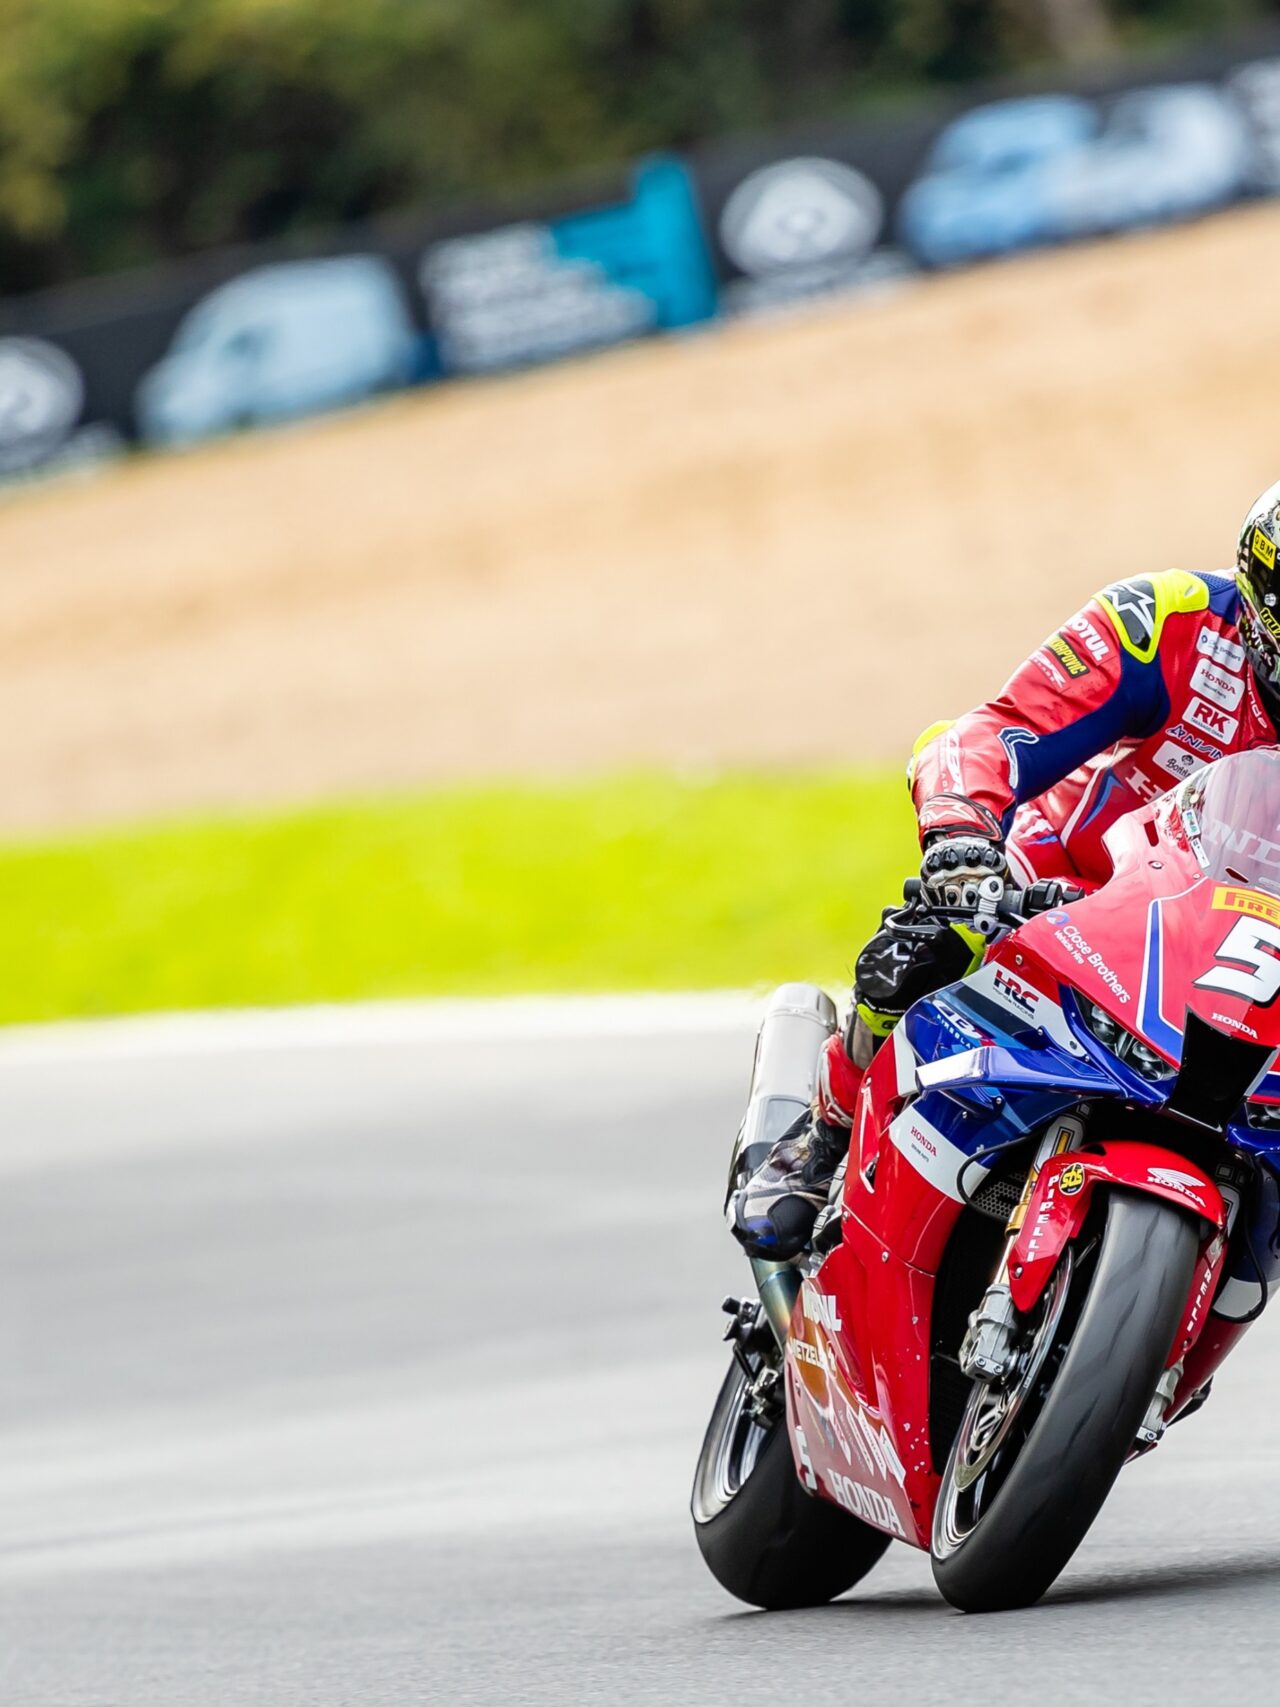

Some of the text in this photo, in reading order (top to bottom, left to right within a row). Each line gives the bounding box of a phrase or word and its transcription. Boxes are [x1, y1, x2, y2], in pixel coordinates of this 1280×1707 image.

[1200, 669, 1236, 695] HONDA
[1193, 703, 1230, 734] RK
[1054, 930, 1085, 965] Vehicle Hire
[1062, 925, 1131, 1004] Close Brothers
[993, 969, 1040, 1013] HRC
[1211, 1012, 1259, 1040] HONDA
[910, 1126, 937, 1157] HONDA
[1147, 1176, 1206, 1208] HONDA
[826, 1468, 907, 1538] HONDA
